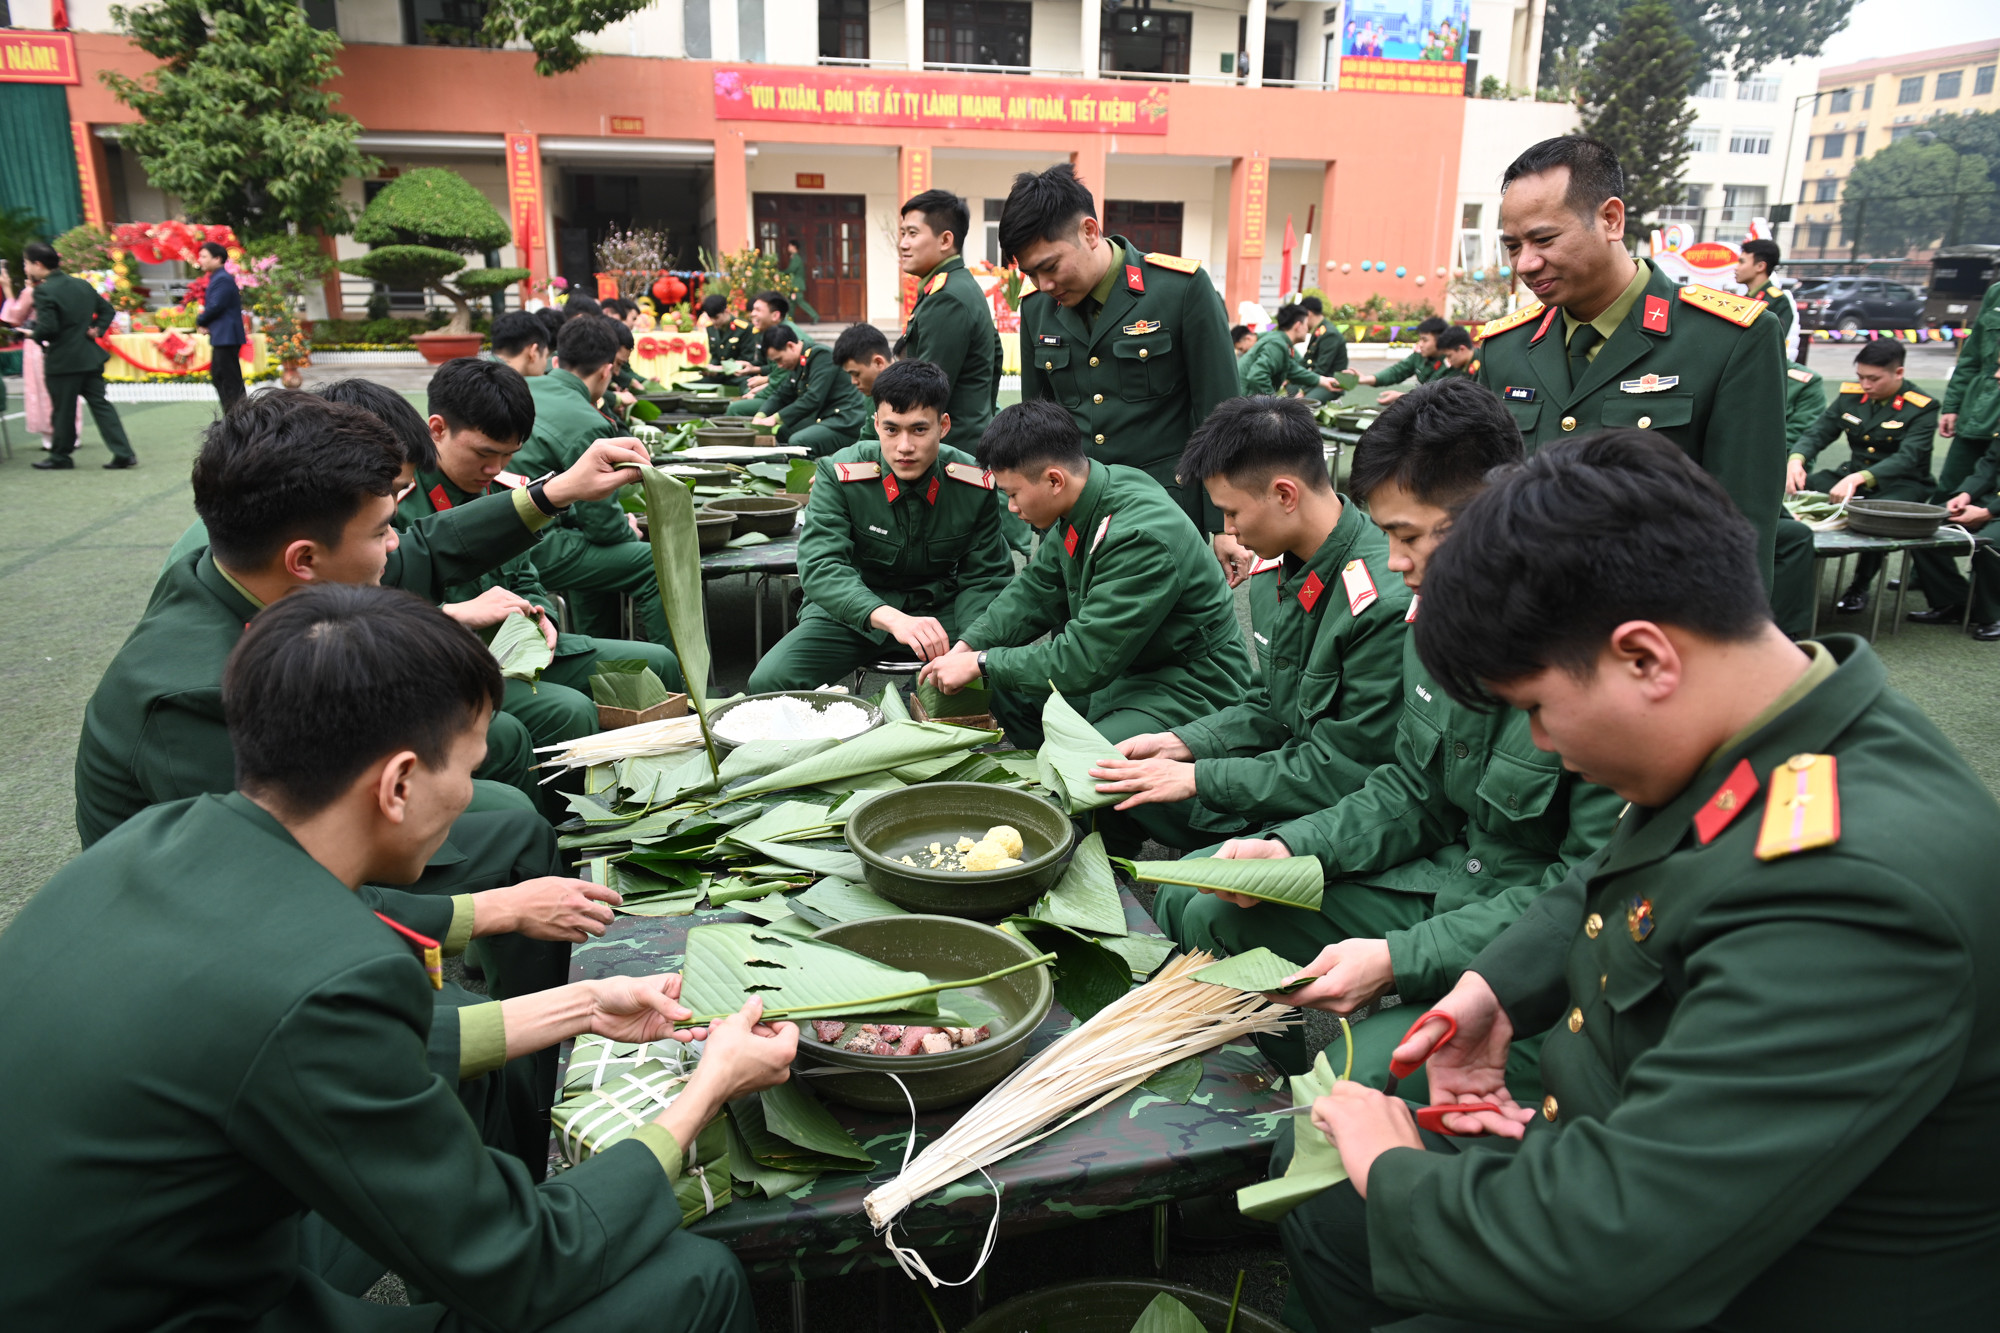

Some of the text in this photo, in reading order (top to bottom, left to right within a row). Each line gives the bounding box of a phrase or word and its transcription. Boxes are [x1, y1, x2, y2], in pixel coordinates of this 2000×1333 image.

[5, 40, 60, 72] NĂM!
[751, 85, 775, 109] VUI
[778, 83, 822, 114] XUÂN,
[824, 85, 854, 113] ĐÓN
[856, 84, 880, 114] TẾT
[883, 84, 900, 115] ẤT
[922, 89, 958, 117] LÀNH
[961, 94, 1005, 123] MẠNH,
[1007, 97, 1027, 119] AN
[1029, 93, 1068, 123] TOÀN,
[1070, 93, 1097, 122] TIẾT
[1099, 96, 1137, 127] KIỆM!
